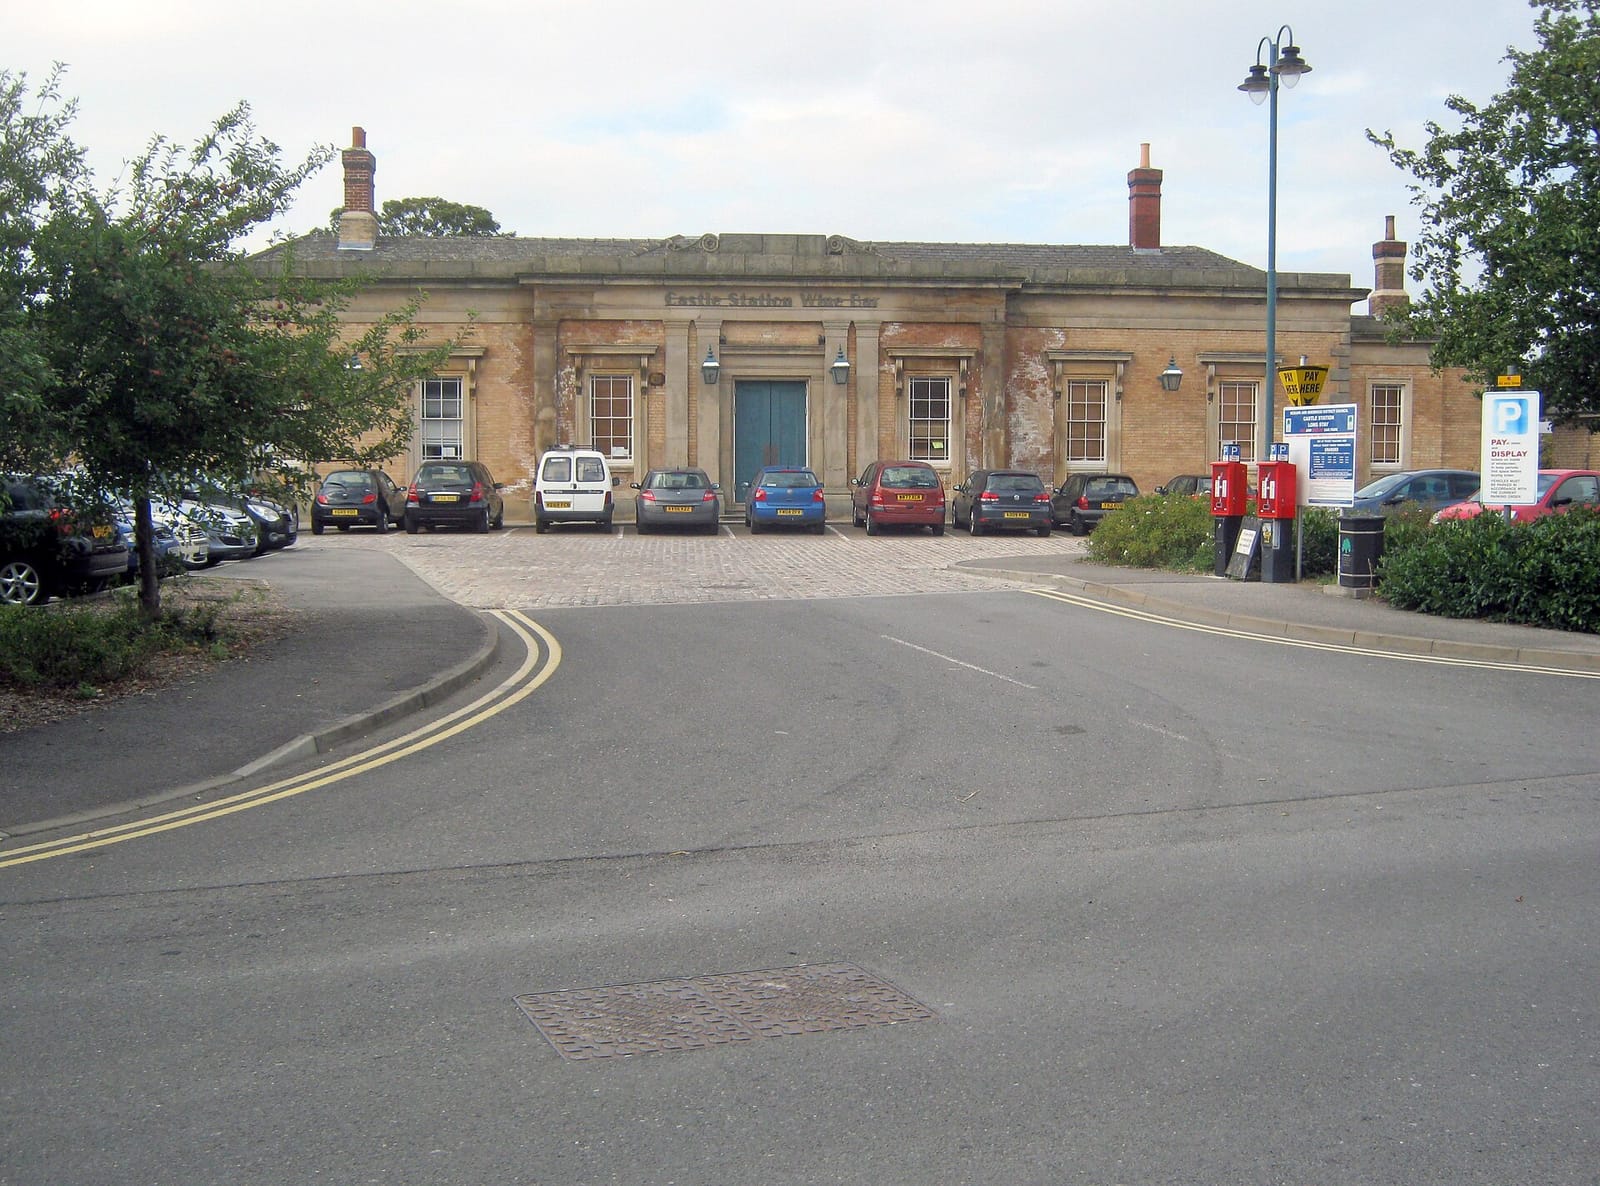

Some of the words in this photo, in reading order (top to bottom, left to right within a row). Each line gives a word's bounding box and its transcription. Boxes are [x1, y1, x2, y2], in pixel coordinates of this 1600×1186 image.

[664, 291, 720, 307] Castle
[727, 292, 792, 307] Station
[1304, 371, 1320, 382] PAY
[1300, 383, 1320, 394] HERE
[1498, 402, 1522, 433] P
[1231, 446, 1238, 456] P
[1279, 445, 1287, 455] P
